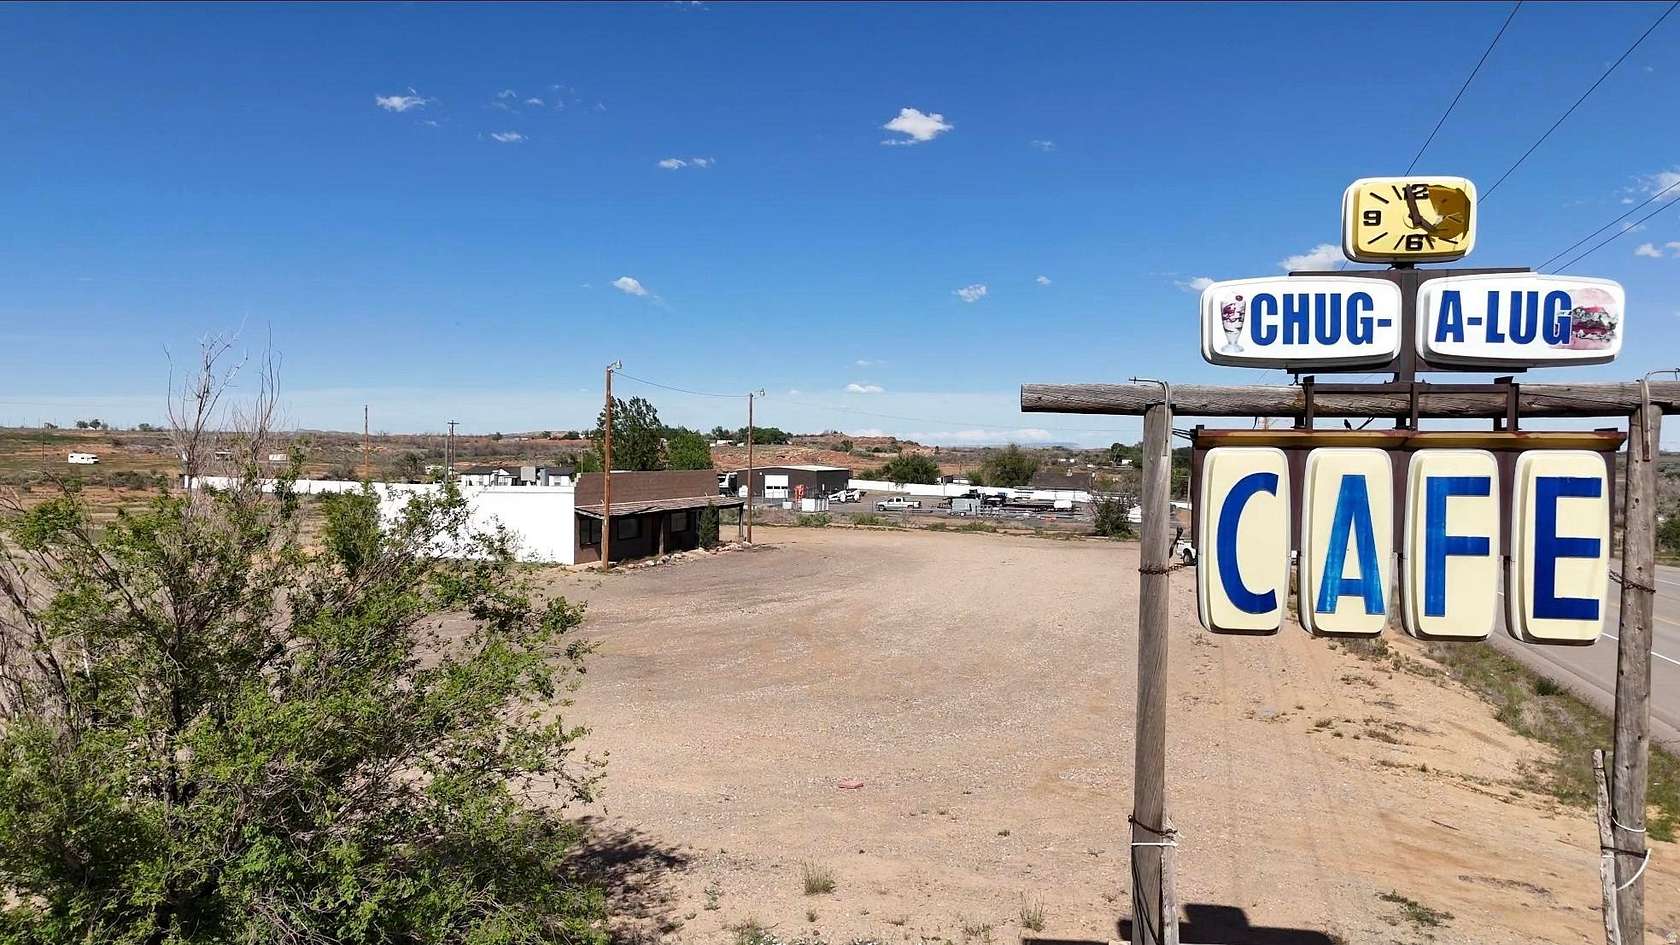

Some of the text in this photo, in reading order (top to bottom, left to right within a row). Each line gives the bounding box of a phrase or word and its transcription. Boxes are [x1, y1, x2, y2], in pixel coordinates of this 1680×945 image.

[1363, 210, 1381, 226] 9
[1405, 234, 1424, 251] 6
[1250, 290, 1572, 346] CHUG- A-LUG
[1216, 472, 1603, 620] CAFE
